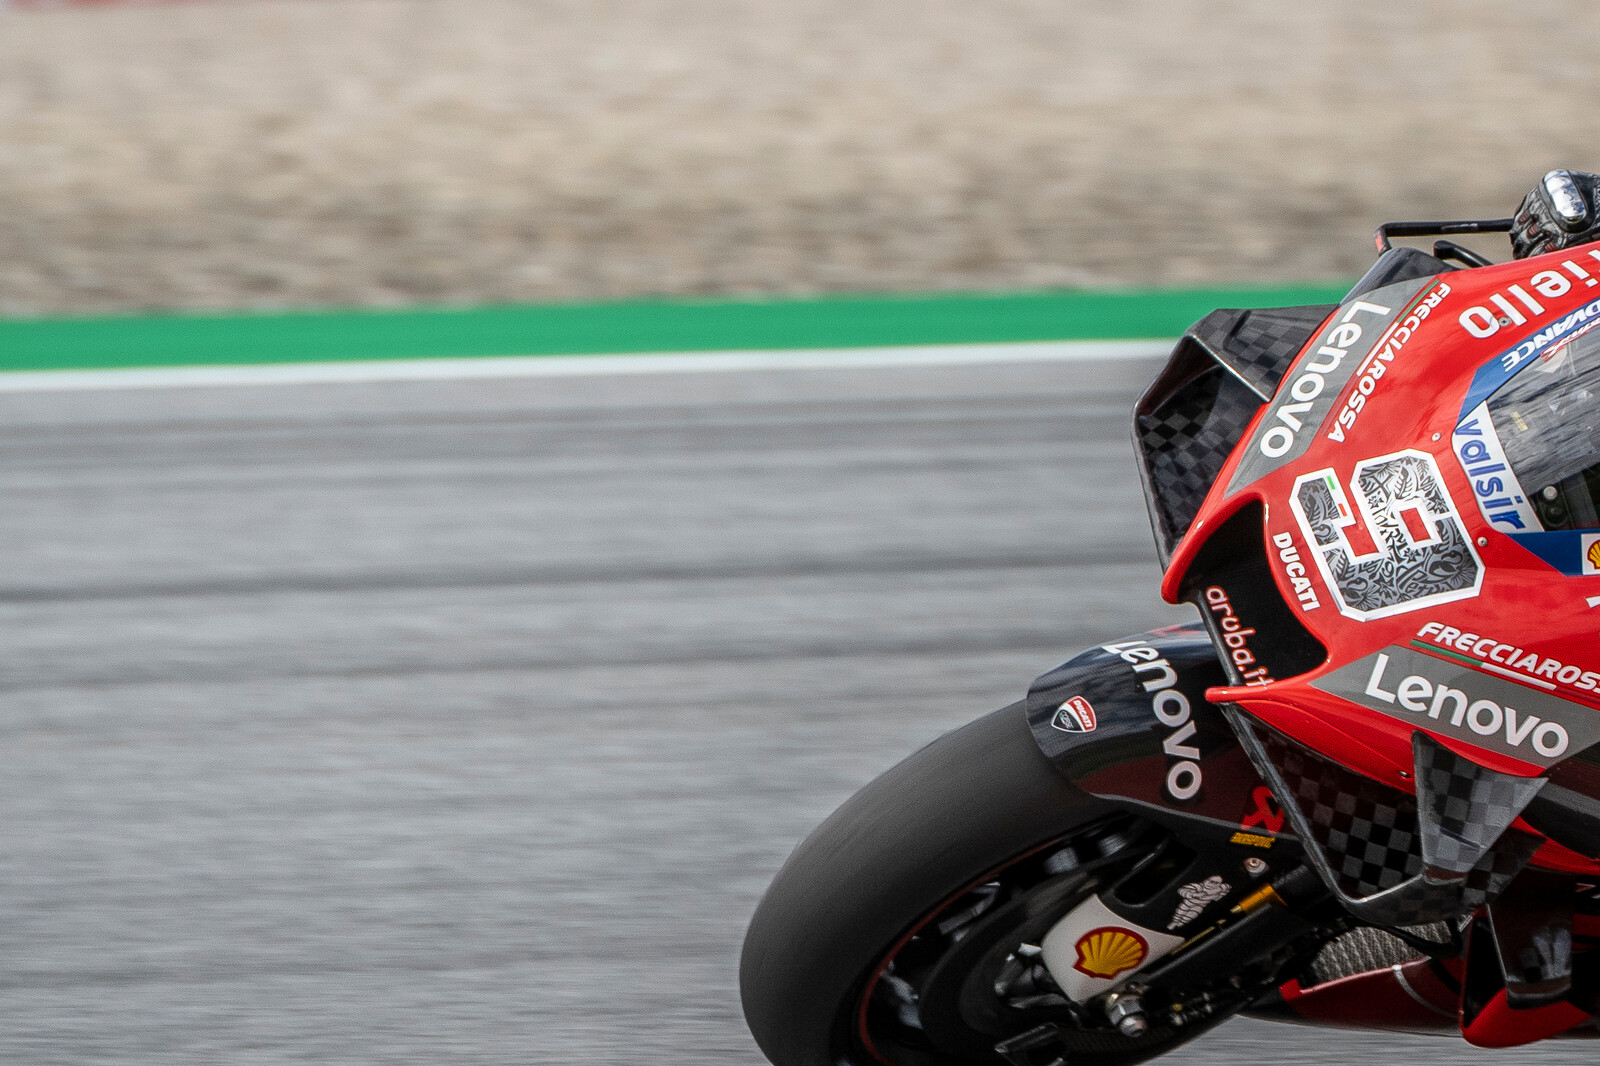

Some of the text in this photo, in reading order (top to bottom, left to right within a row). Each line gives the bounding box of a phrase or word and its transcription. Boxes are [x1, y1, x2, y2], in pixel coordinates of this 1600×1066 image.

[1260, 301, 1391, 458] Lenovo
[1328, 283, 1451, 442] FRECCIAROSSA
[1455, 418, 1527, 532] valsir
[1273, 531, 1320, 612] DUCATI
[1289, 448, 1486, 622] 9
[1205, 584, 1275, 689] aruba.it
[1072, 700, 1093, 728] DUCATI
[1101, 640, 1202, 800] Lenovo
[1365, 653, 1569, 758] Lenovo
